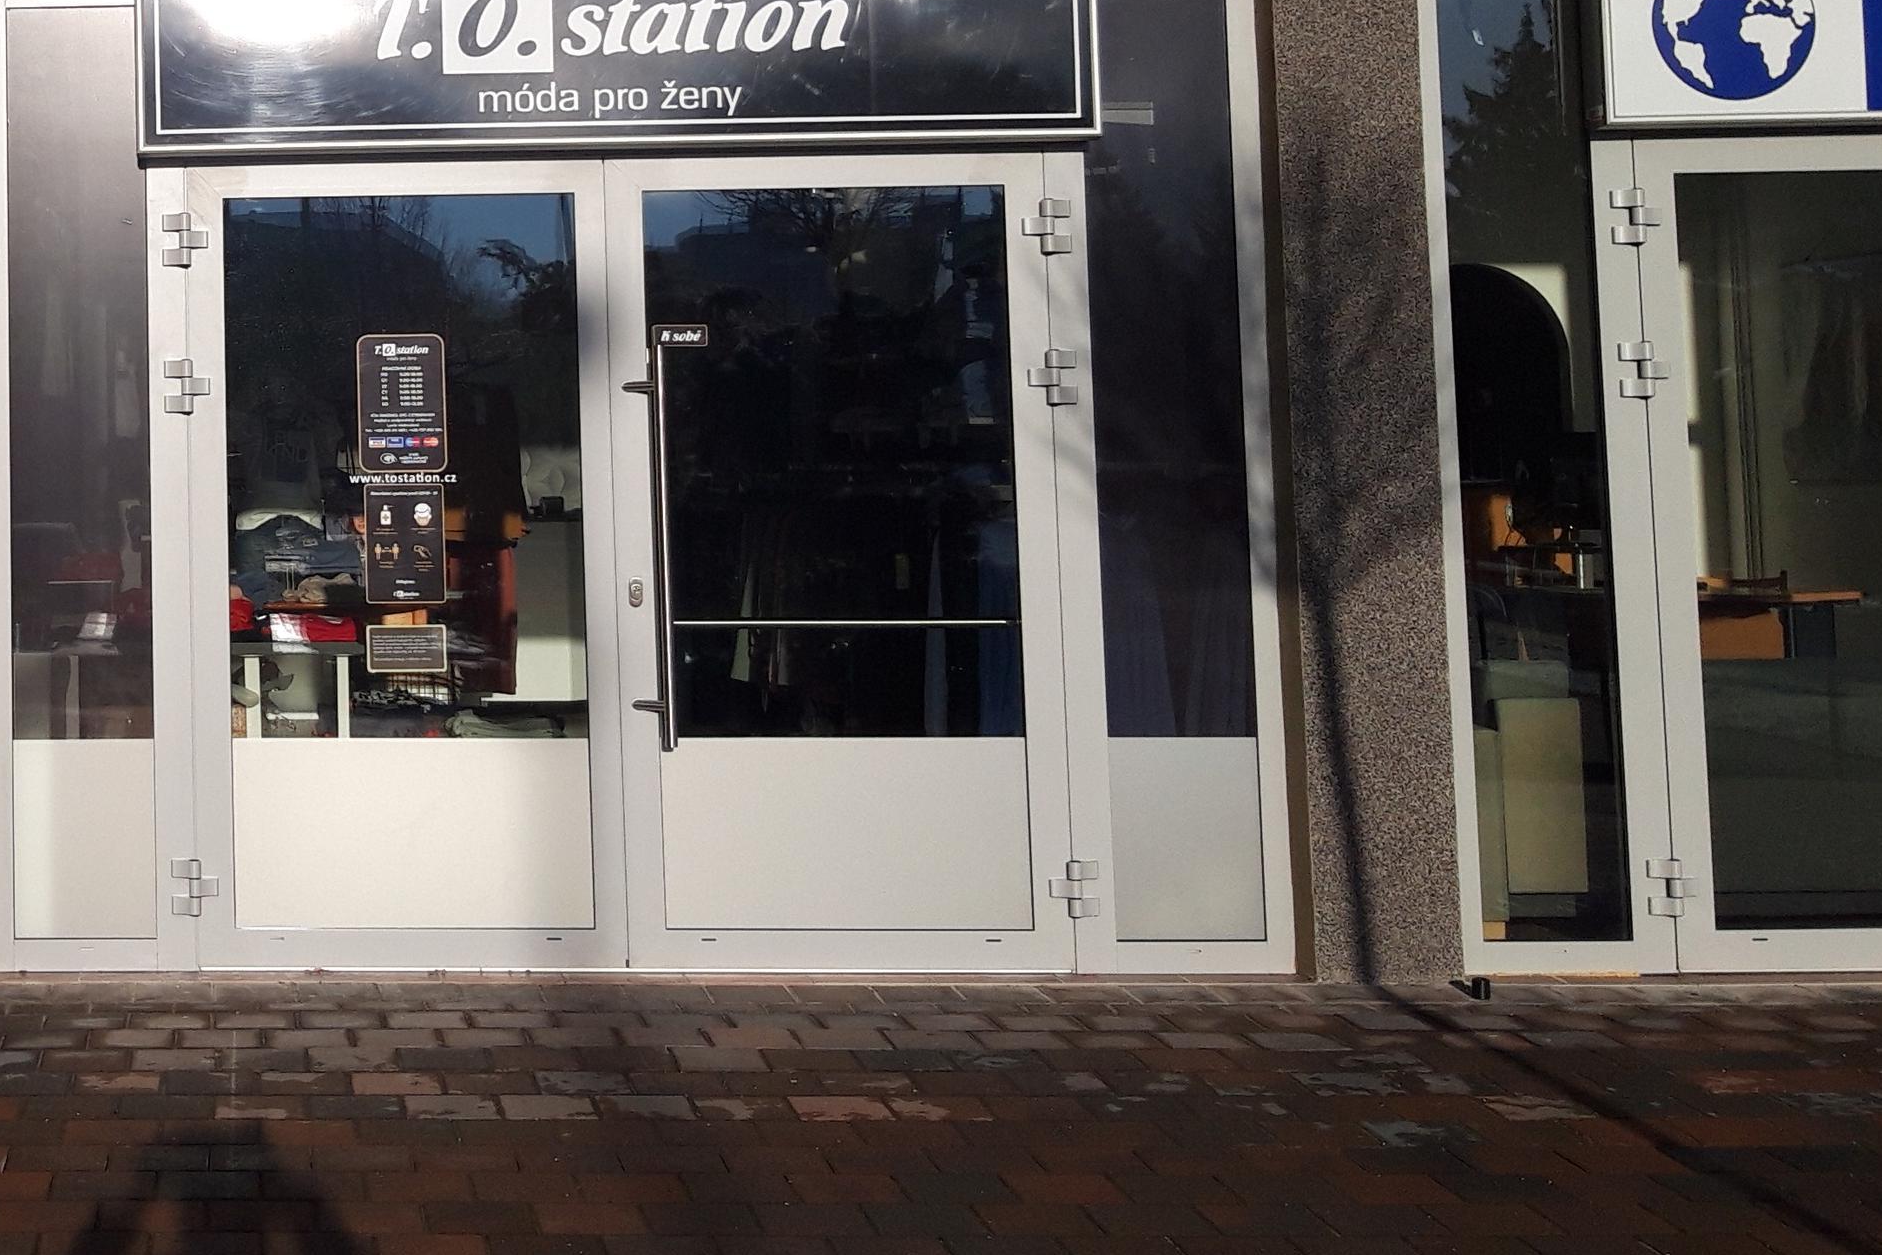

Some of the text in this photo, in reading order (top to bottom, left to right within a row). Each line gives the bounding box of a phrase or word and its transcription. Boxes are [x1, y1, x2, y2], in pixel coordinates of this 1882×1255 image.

[478, 78, 743, 121] móda pro ženy
[396, 344, 429, 355] station
[349, 472, 458, 484] www.tostation.cz
